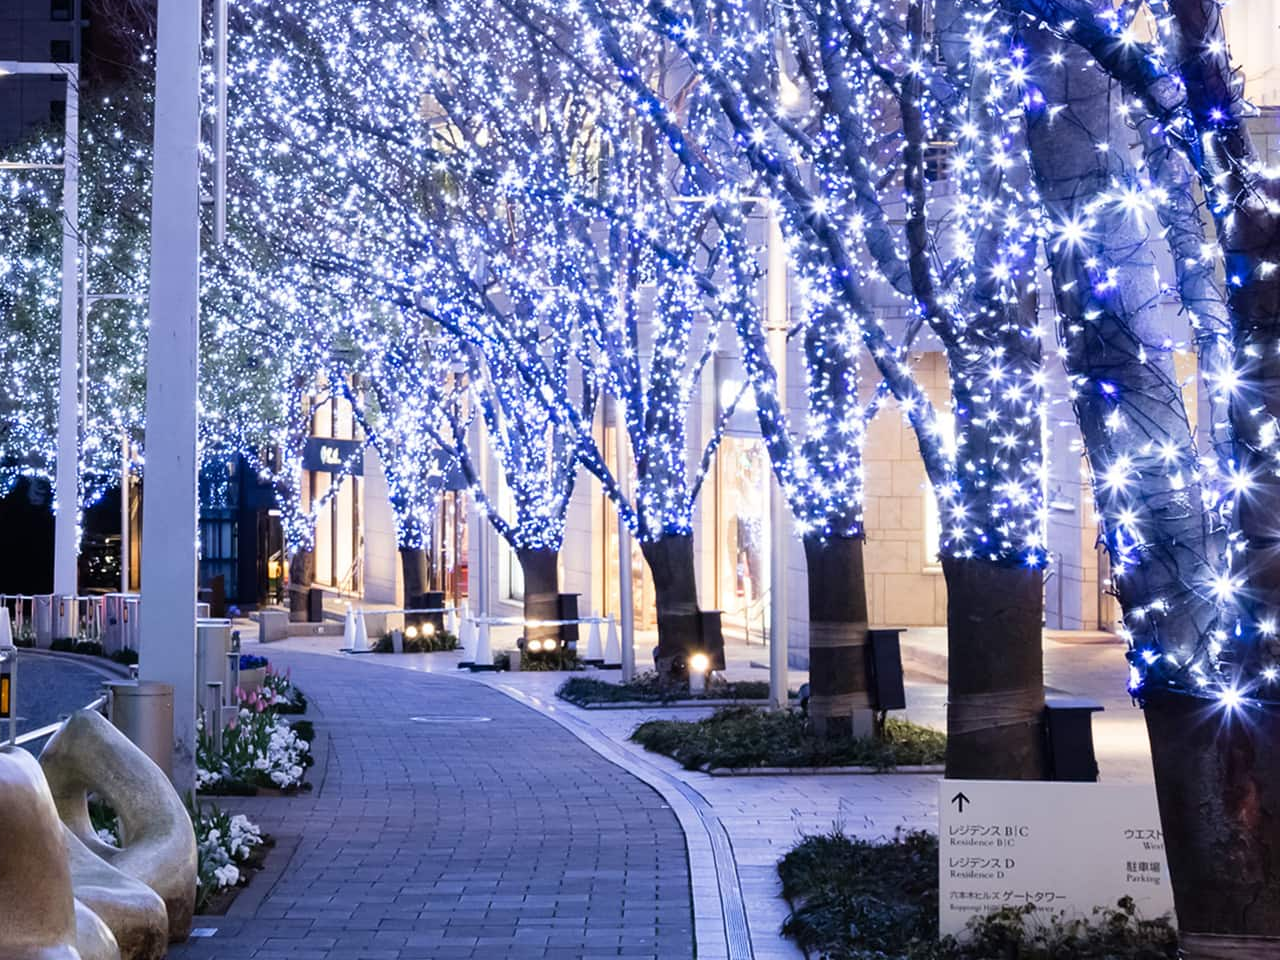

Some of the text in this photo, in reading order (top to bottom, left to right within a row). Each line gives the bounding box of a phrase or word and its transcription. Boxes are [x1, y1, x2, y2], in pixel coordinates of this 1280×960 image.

[949, 825, 1001, 836] レジデンス
[950, 838, 994, 846] Residence
[949, 857, 1015, 869] レジデンス D
[1127, 862, 1161, 873] 駐車場
[950, 870, 994, 878] Residence
[1127, 874, 1161, 885] Parking
